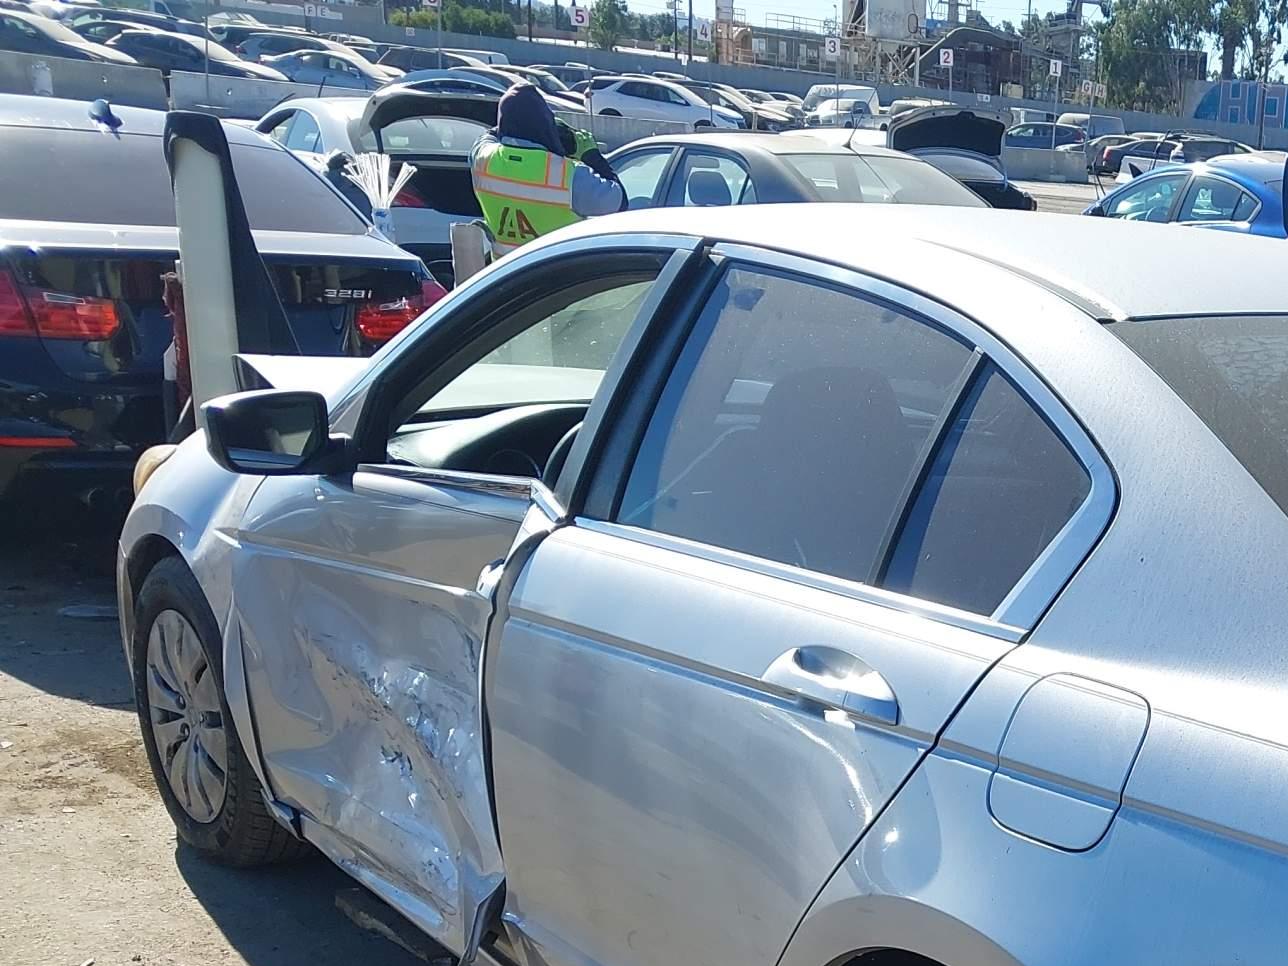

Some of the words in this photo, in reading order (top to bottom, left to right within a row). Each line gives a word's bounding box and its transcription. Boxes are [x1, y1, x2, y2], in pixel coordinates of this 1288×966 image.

[575, 9, 585, 24] 5
[700, 24, 708, 39] 4
[828, 40, 836, 53] 3
[942, 51, 951, 63] 2
[1051, 62, 1059, 74] 1
[1083, 82, 1090, 93] G
[1098, 87, 1105, 97] H
